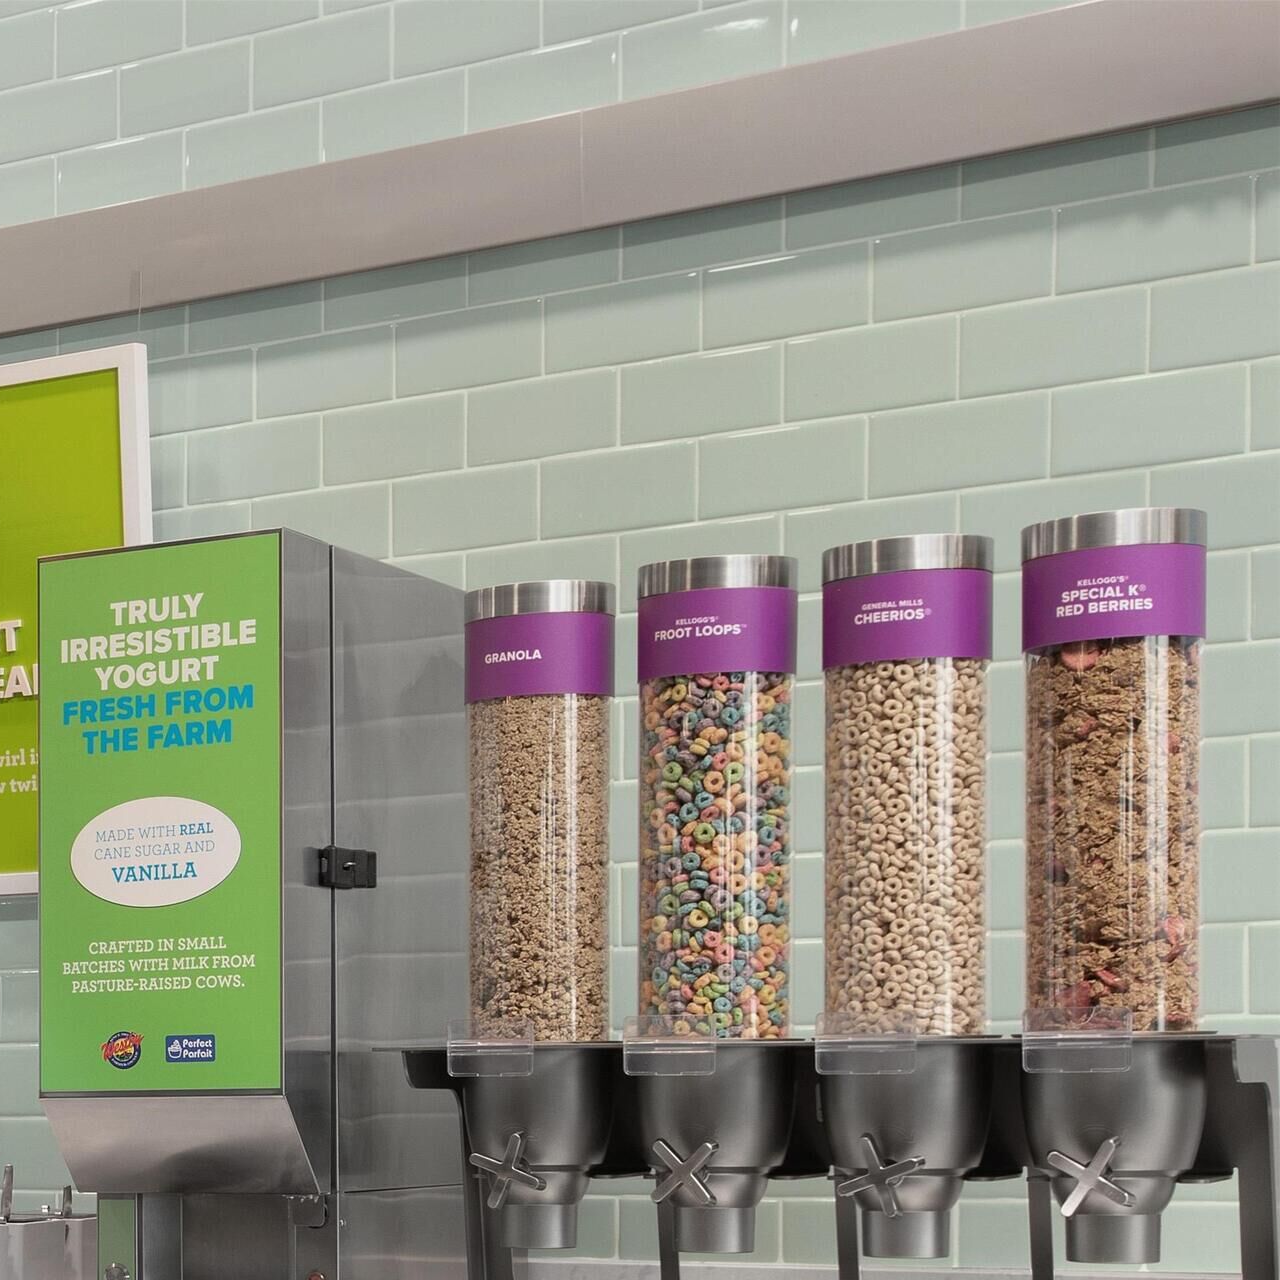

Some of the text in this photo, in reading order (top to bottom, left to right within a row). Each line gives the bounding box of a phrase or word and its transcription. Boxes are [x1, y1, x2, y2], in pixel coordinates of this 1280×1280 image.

[861, 598, 924, 611] GENERAL MILLS
[1062, 586, 1124, 603] SPECIAL
[110, 592, 204, 626] TRULY
[1056, 598, 1153, 618] RED BERRIES
[60, 618, 256, 664] IRRESISTIBLE
[654, 627, 692, 642] FROOT
[484, 649, 542, 665] GRANOLA
[95, 655, 219, 691] YOGURT
[62, 684, 254, 726] FRESH FROM
[82, 718, 232, 755] THE FARM
[9, 774, 38, 793] twi
[95, 822, 214, 843] MADE WITH REAL
[94, 840, 215, 861] CANE SUGAR AND
[112, 862, 198, 883] VANILLA
[88, 936, 227, 955] CRAFTED IN SMALL
[62, 954, 256, 975] BATCHES WITH MILK FROM
[72, 974, 245, 993] PASTURE-RAISED COWS.
[182, 1038, 212, 1048] Perfect
[182, 1049, 212, 1058] Parfait
